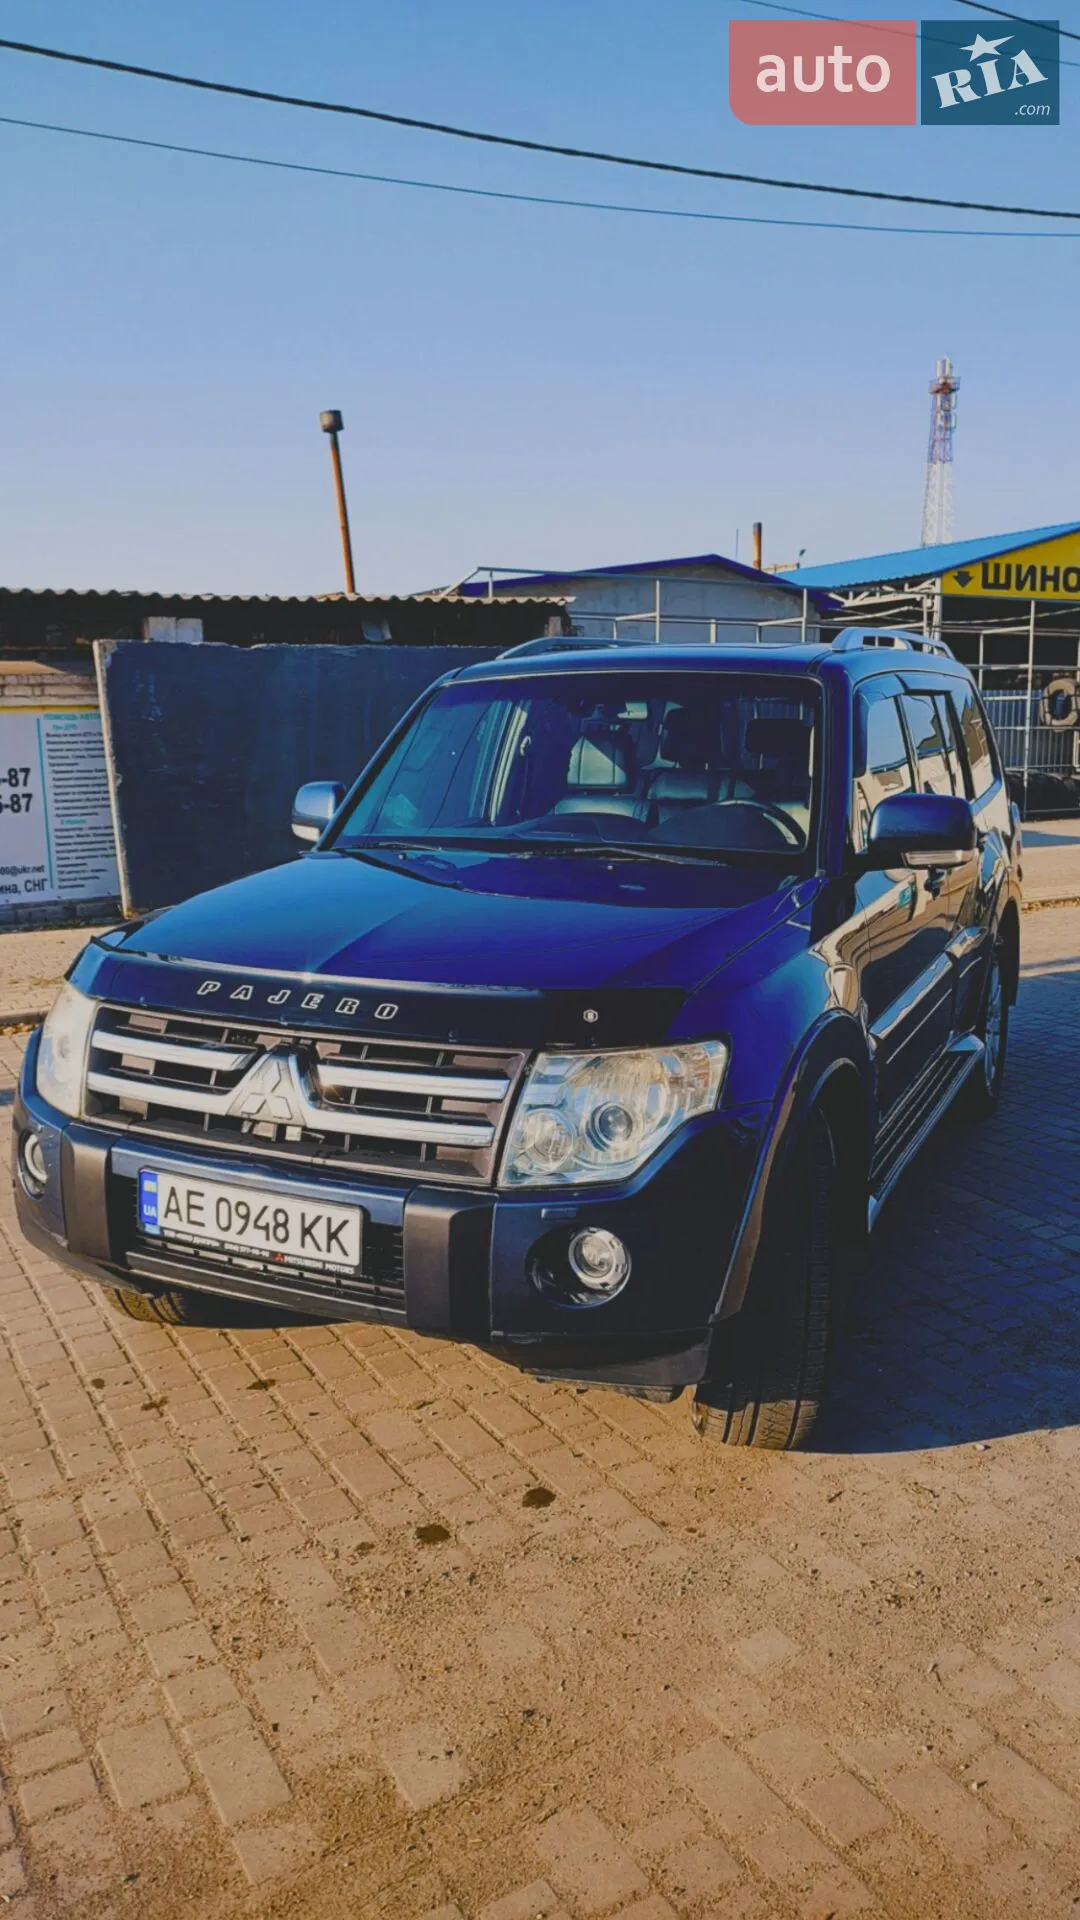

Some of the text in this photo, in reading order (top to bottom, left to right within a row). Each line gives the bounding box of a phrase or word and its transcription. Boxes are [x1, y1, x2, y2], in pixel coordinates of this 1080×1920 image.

[981, 562, 1080, 593] ШИНО
[0, 793, 33, 814] -87
[24, 878, 48, 893] СНГ
[197, 981, 399, 1020] PAJERO
[143, 1204, 157, 1218] UA
[164, 1186, 349, 1257] AE 0948 KK
